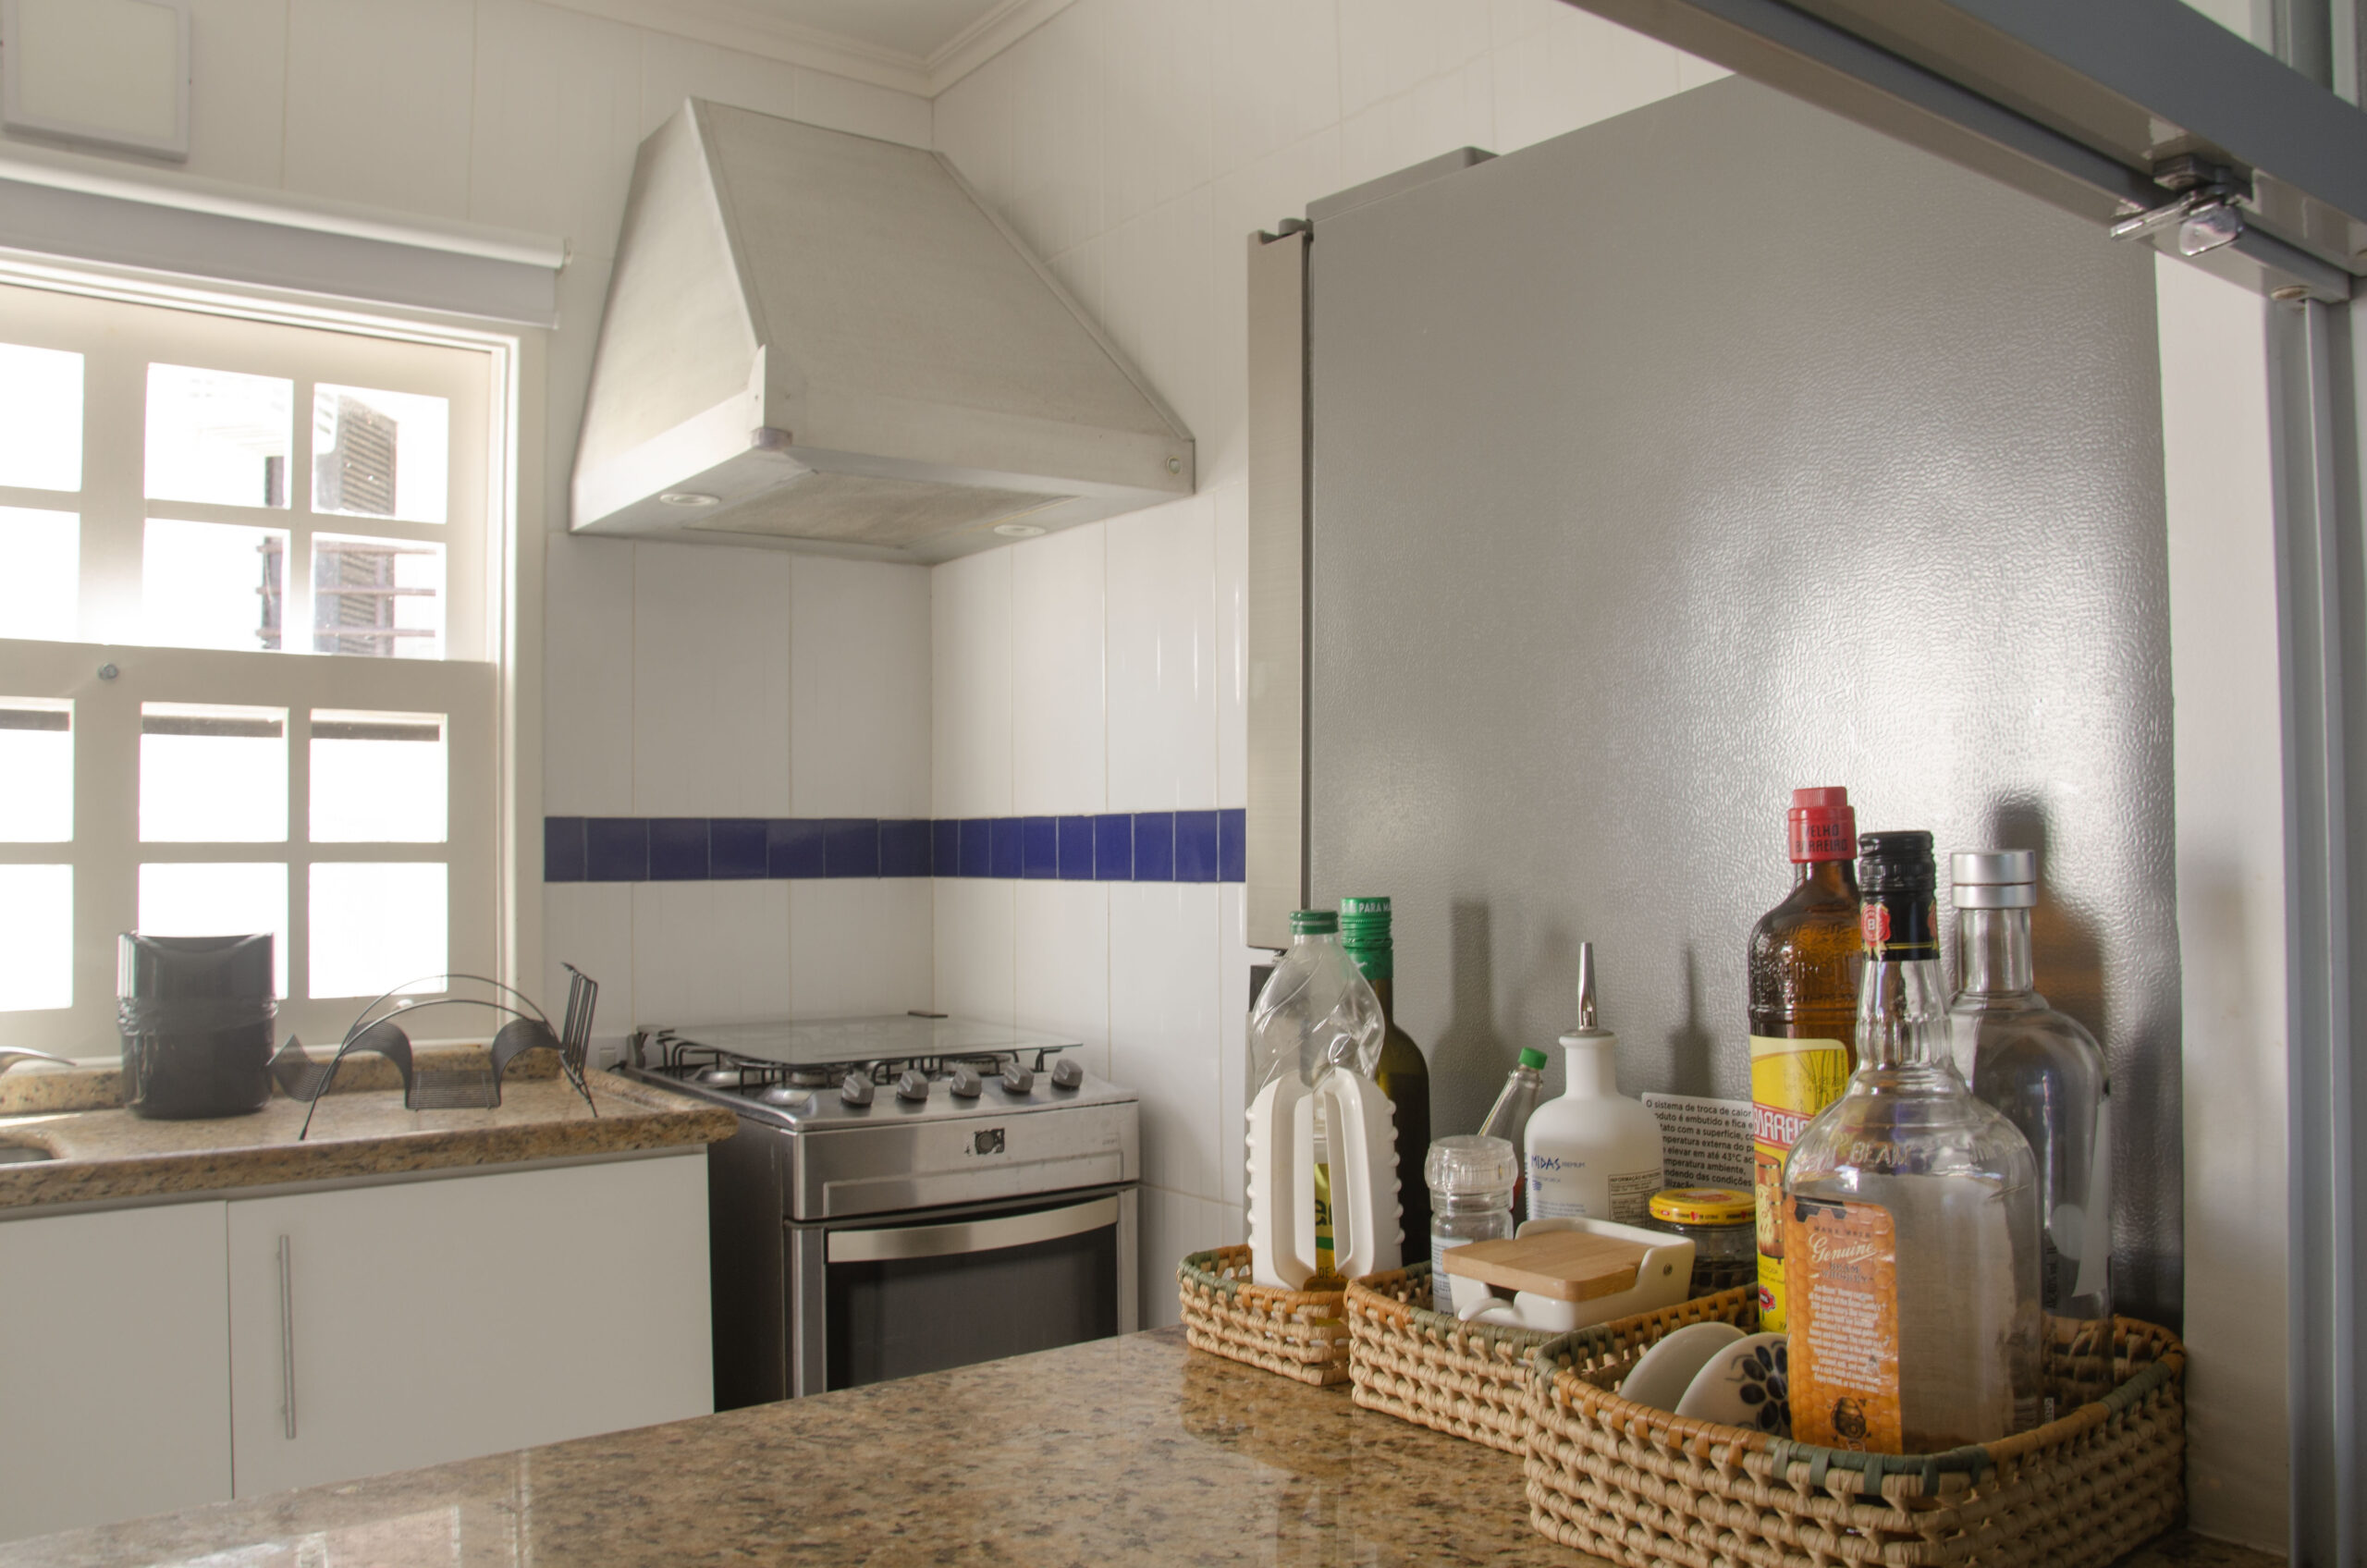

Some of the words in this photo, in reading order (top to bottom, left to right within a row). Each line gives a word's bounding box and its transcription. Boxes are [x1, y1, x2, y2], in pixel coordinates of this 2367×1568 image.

[1806, 824, 1840, 838] VELHO
[1796, 839, 1848, 852] BARREIRO
[1358, 902, 1381, 913] PARA
[1646, 1099, 1652, 1109] O
[1654, 1100, 1683, 1111] sistema
[1685, 1102, 1695, 1112] de
[1697, 1104, 1717, 1114] troca
[1720, 1106, 1730, 1116] de
[1731, 1107, 1751, 1118] calor
[1685, 1114, 1723, 1126] embutido
[1731, 1118, 1746, 1129] fica
[1677, 1125, 1694, 1134] com
[1696, 1127, 1700, 1135] a
[1702, 1139, 1732, 1150] externa
[1734, 1141, 1745, 1152] do
[1668, 1146, 1691, 1156] elevar
[1693, 1149, 1705, 1158] em
[1707, 1150, 1720, 1160] até
[1531, 1155, 1562, 1171] MIDAS
[1707, 1162, 1747, 1175] ambiente,
[1696, 1170, 1710, 1182] das
[1711, 1173, 1752, 1188] condições
[1809, 1233, 1878, 1264] Genuine
